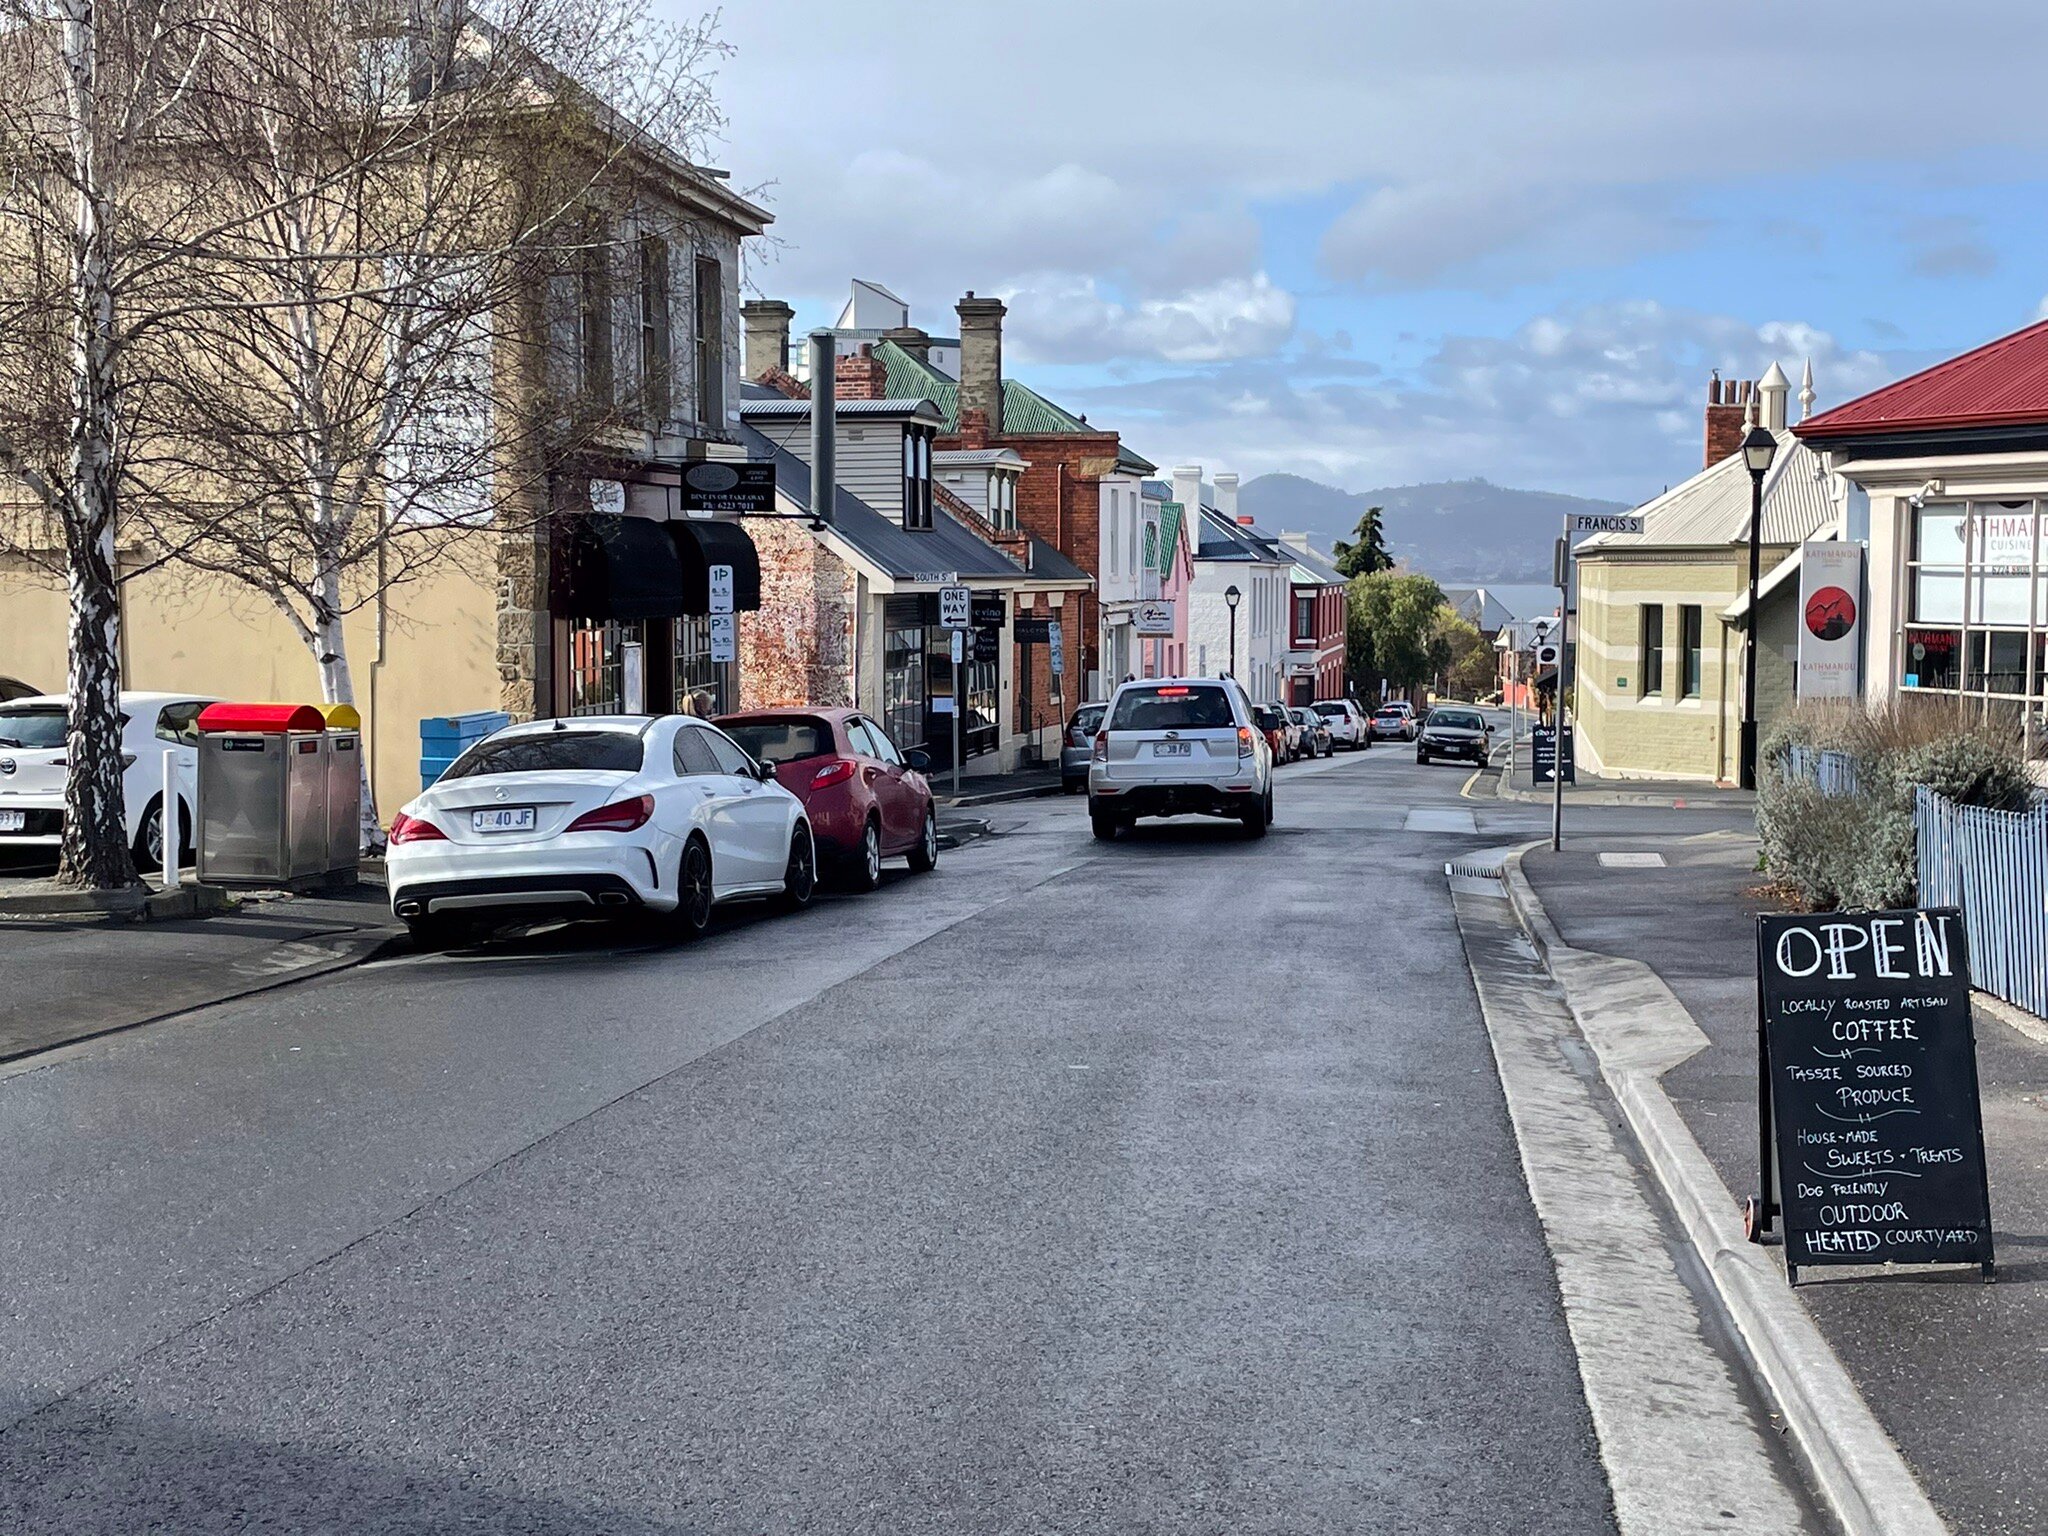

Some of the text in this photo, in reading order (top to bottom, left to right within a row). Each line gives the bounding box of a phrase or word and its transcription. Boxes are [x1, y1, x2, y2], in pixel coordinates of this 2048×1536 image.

[1578, 516, 1626, 531] FRANCIS
[1805, 550, 1859, 558] KATHMANDU
[1991, 540, 2032, 551] CUISINE
[915, 573, 939, 581] SOUTH
[944, 591, 965, 601] ONE
[943, 604, 966, 613] WAY
[982, 608, 1001, 616] vino
[1802, 662, 1856, 671] KATHMANDU
[475, 810, 532, 827] J 40 JF
[1776, 912, 1953, 979] OPEN
[1781, 998, 1949, 1021] LOCALLY ROASTED ARTISAN
[1832, 1017, 1919, 1042] COFFEE
[1786, 1065, 1912, 1082] TASSIE SOURCED
[1836, 1086, 1915, 1107] PRODUCE
[1826, 1147, 1963, 1168] SWEETS TREATS
[1798, 1181, 1889, 1199] DOG FRIENDLY
[1820, 1202, 1909, 1227] OUTDOOR
[1805, 1229, 1979, 1253] HEATED COURTYARD
